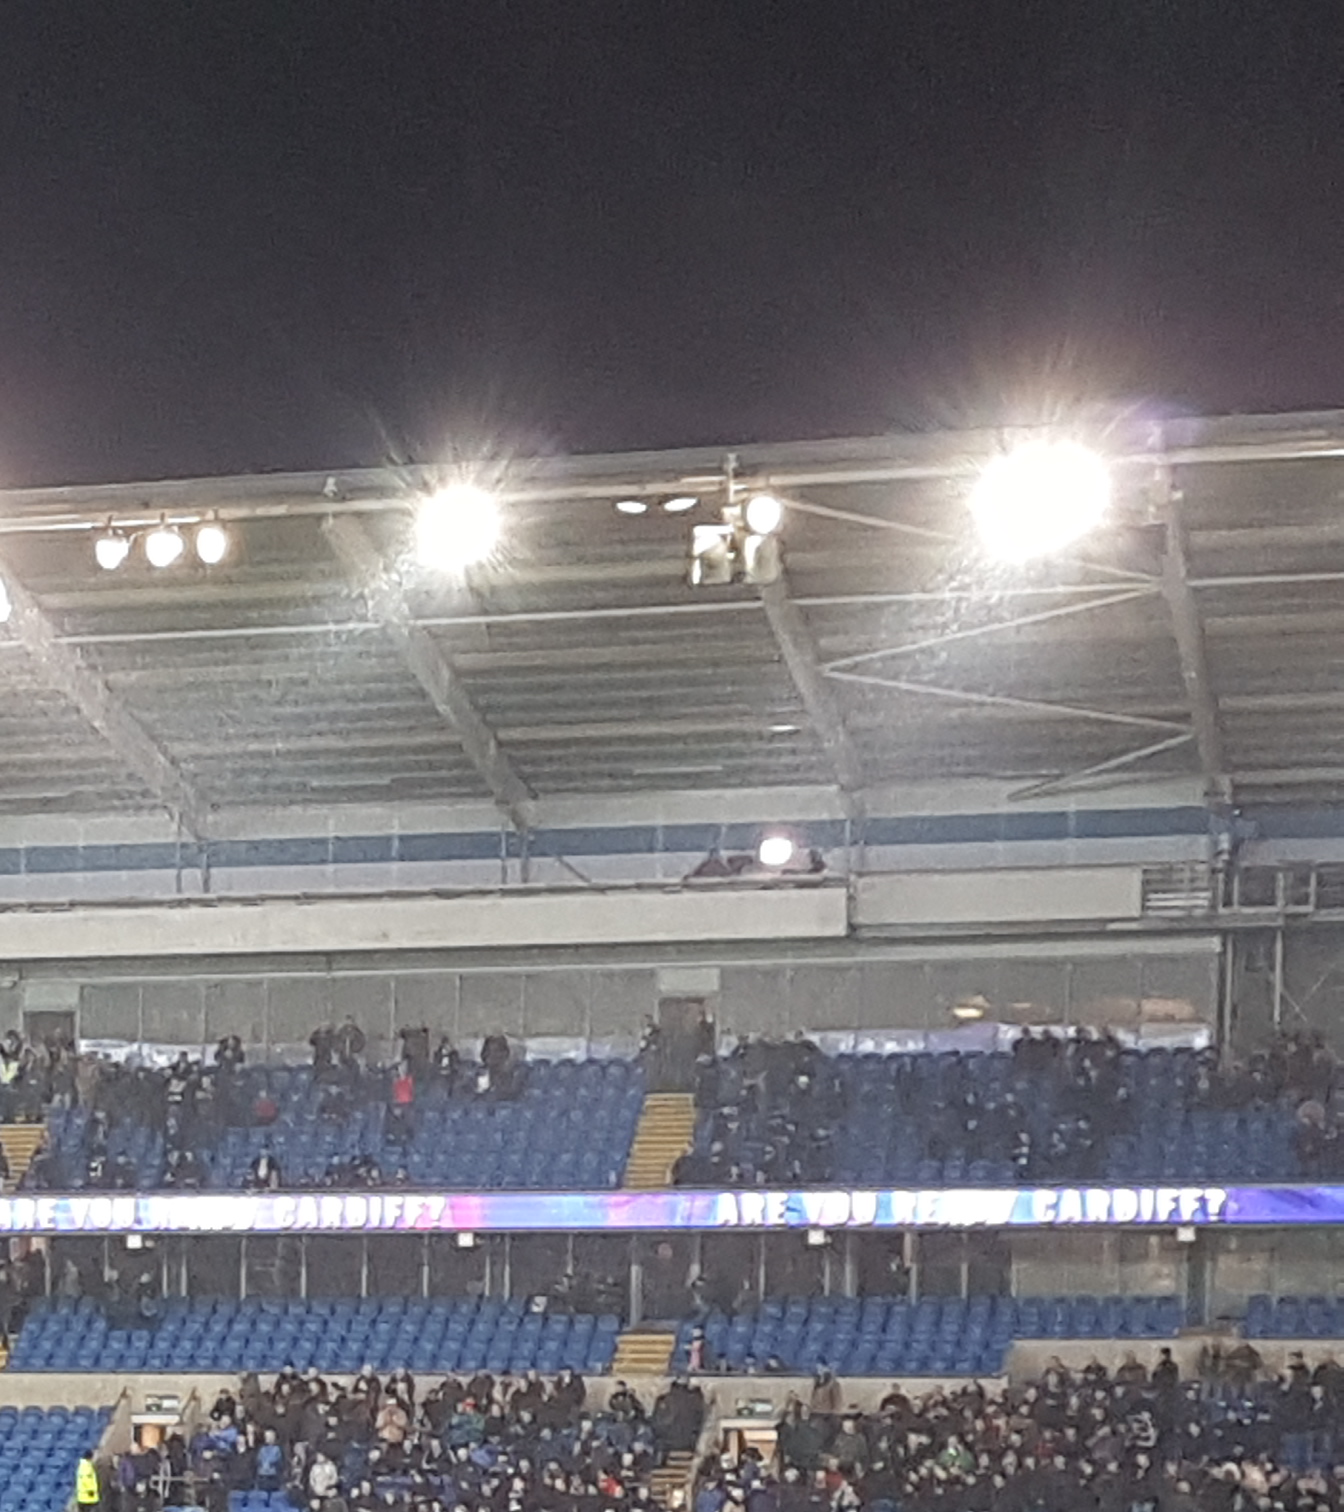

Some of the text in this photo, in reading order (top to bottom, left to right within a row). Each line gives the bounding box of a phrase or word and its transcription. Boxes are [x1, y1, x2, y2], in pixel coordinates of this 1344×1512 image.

[71, 1198, 138, 1229] YOU
[274, 1198, 446, 1229] CARDIFF?
[718, 1191, 786, 1224] ARE
[810, 1191, 877, 1224] YOU
[1034, 1191, 1226, 1224] CARDIFF?
